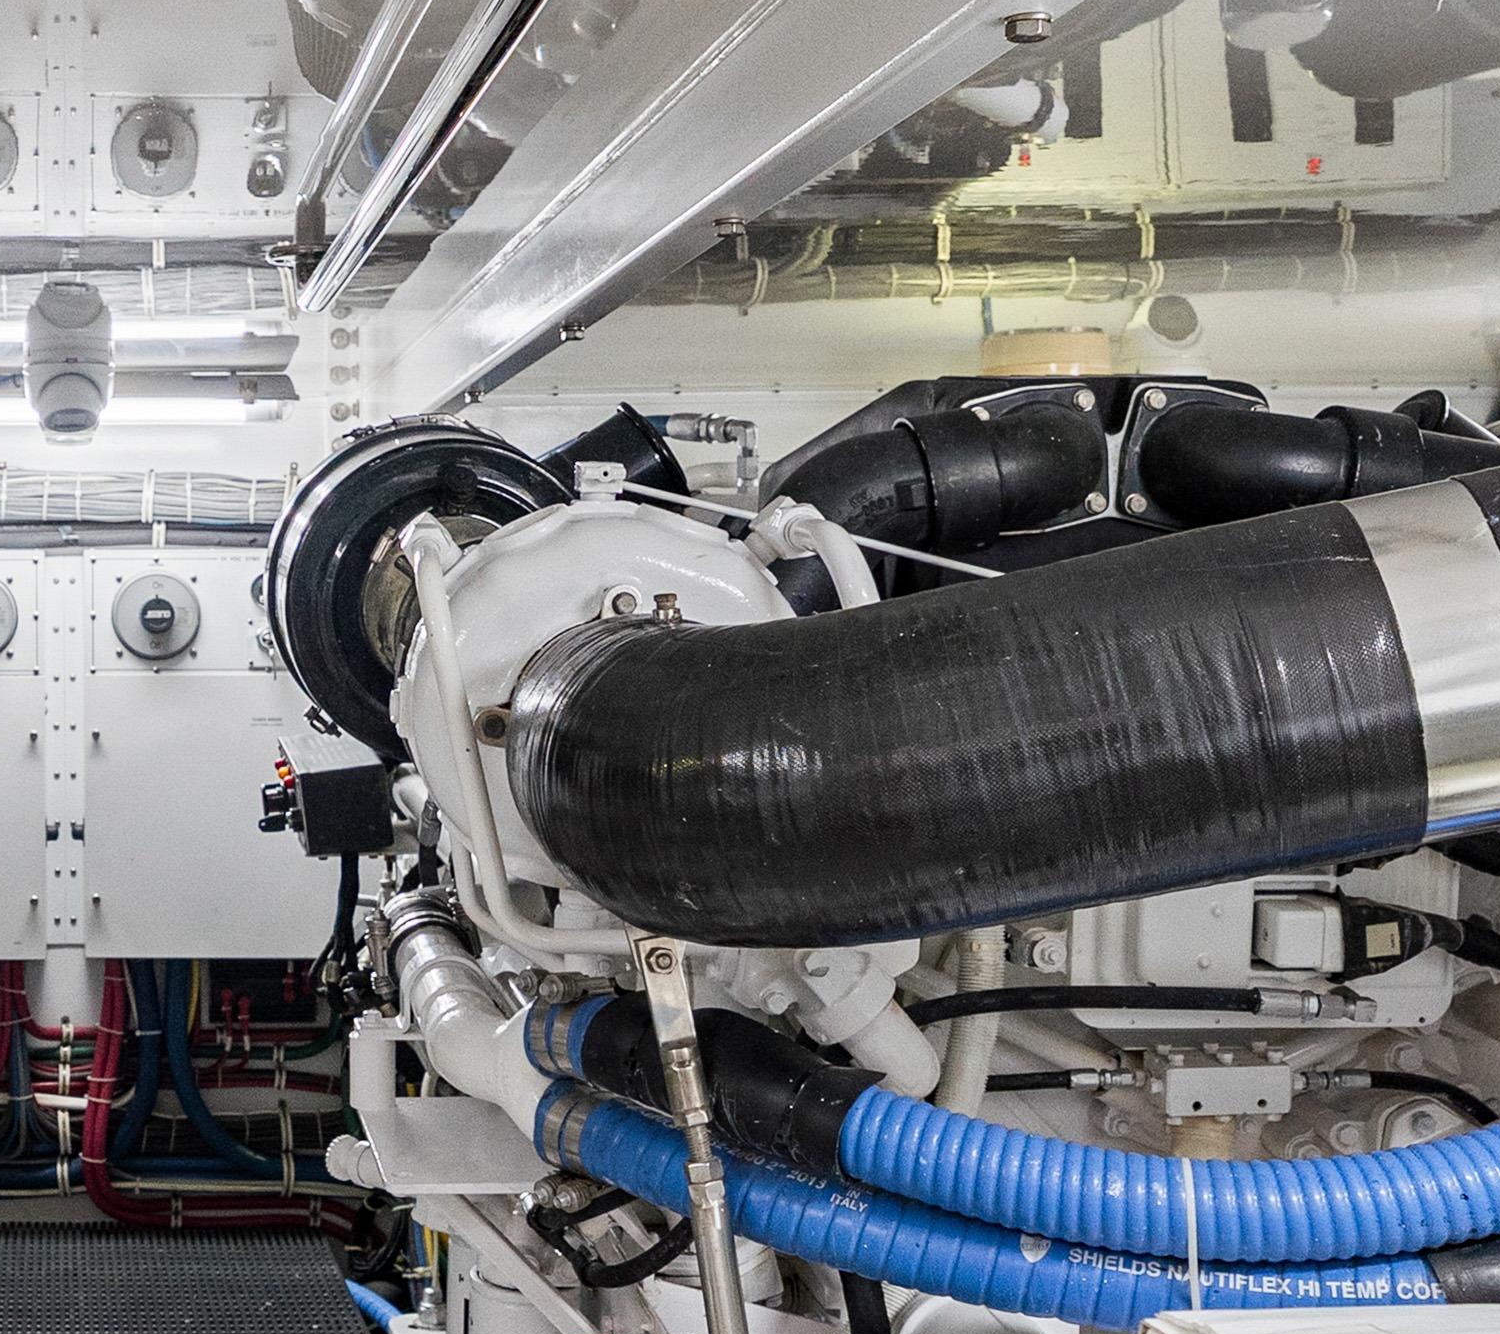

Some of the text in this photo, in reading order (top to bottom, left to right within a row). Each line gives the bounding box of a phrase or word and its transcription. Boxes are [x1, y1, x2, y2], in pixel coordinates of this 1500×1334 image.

[830, 1192, 868, 1214] ITALY
[1068, 1247, 1162, 1278] SHIELDS
[1297, 1279, 1321, 1299] HI
[1326, 1278, 1391, 1300] TEMP
